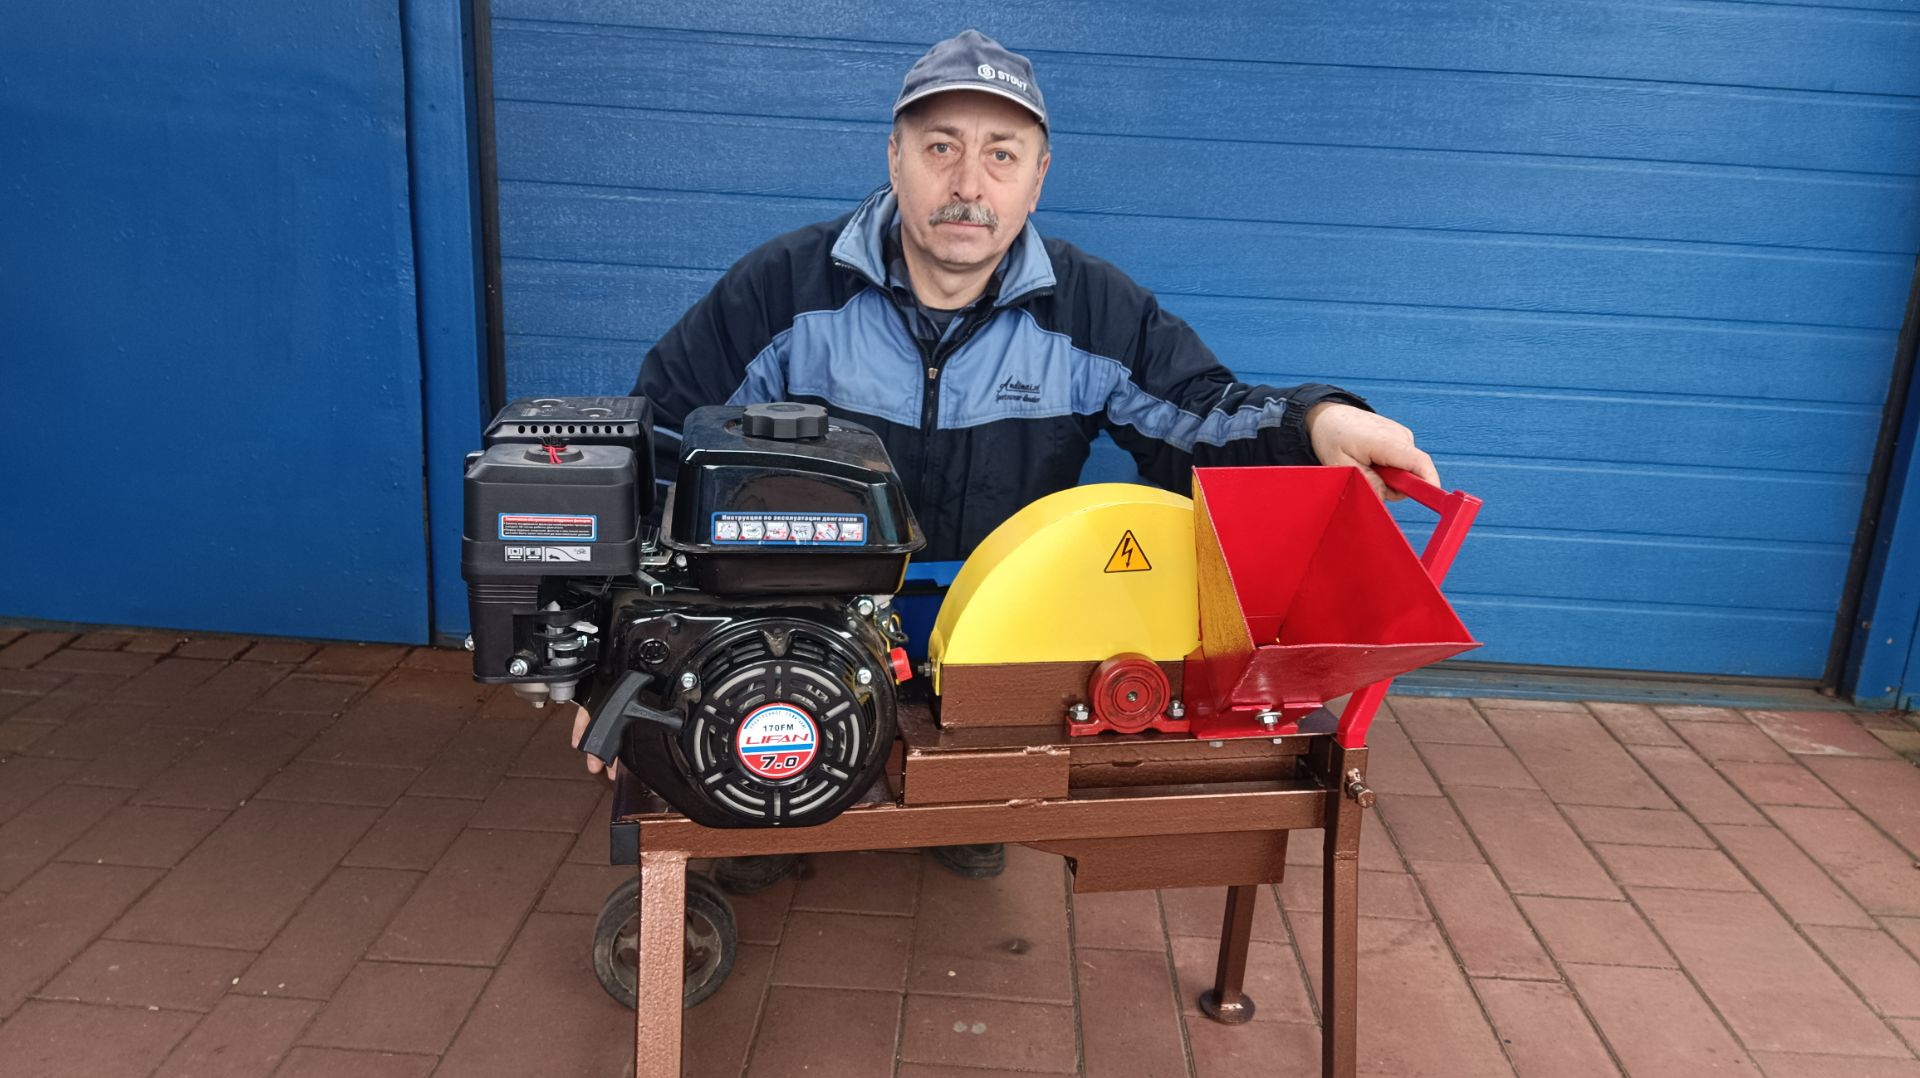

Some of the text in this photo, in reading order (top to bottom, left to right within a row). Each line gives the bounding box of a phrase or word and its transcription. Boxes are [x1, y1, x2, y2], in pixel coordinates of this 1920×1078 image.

[997, 70, 1027, 92] STOUT
[721, 514, 762, 522] Инструкция
[763, 724, 794, 732] 170FM
[746, 733, 809, 745] LIFAN
[760, 754, 799, 770] 7.0
